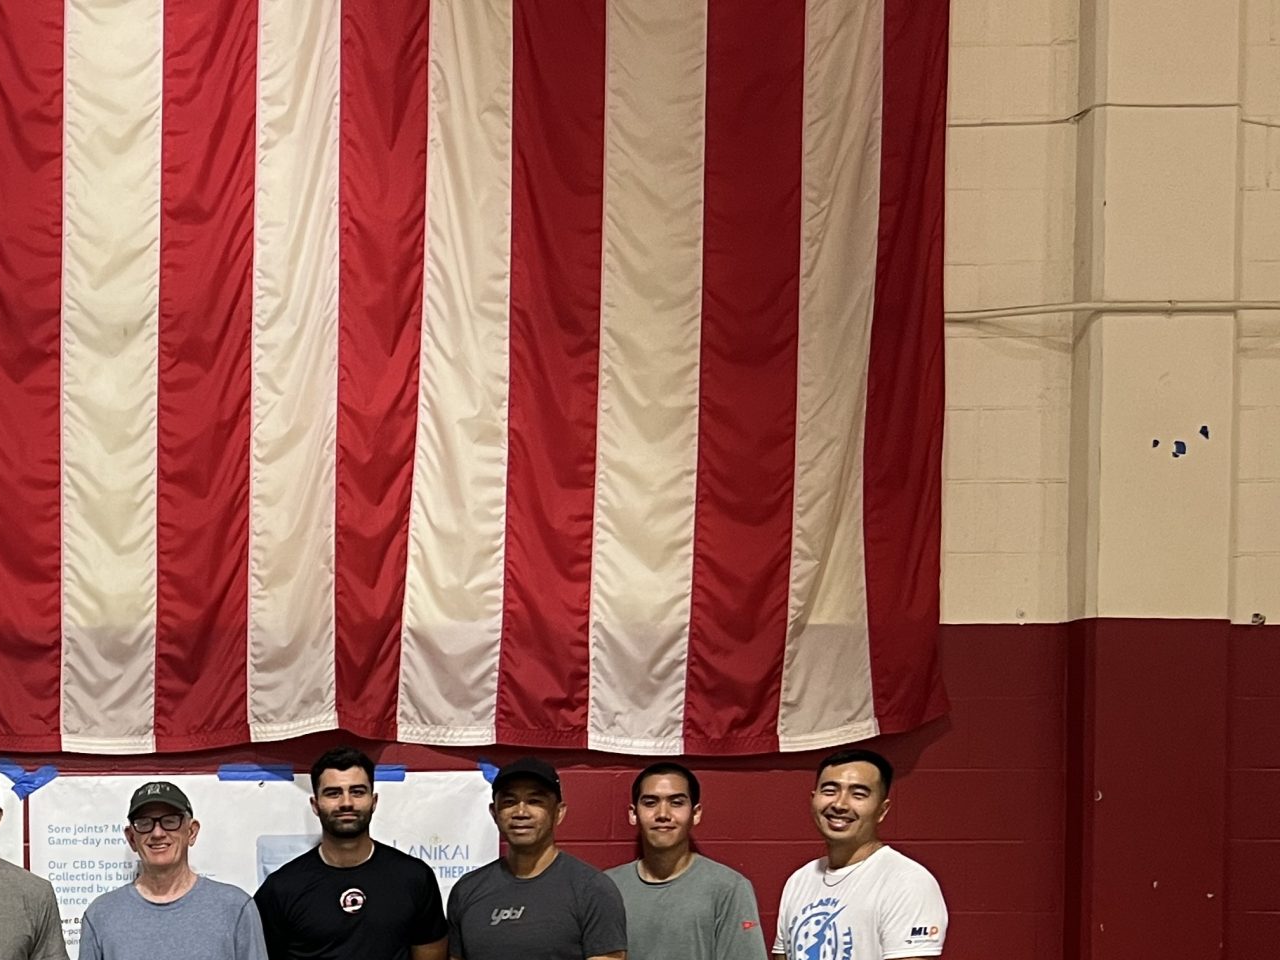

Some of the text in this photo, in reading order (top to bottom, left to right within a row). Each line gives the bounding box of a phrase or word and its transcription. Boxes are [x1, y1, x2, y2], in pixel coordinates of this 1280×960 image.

[48, 825, 71, 833] Sore
[73, 824, 109, 835] joints?
[48, 837, 101, 847] Game-day
[48, 861, 67, 869] Our
[73, 861, 95, 869] CBD
[98, 860, 133, 871] Sports
[48, 872, 102, 881] Collection
[105, 873, 113, 881] is
[55, 885, 93, 893] owered
